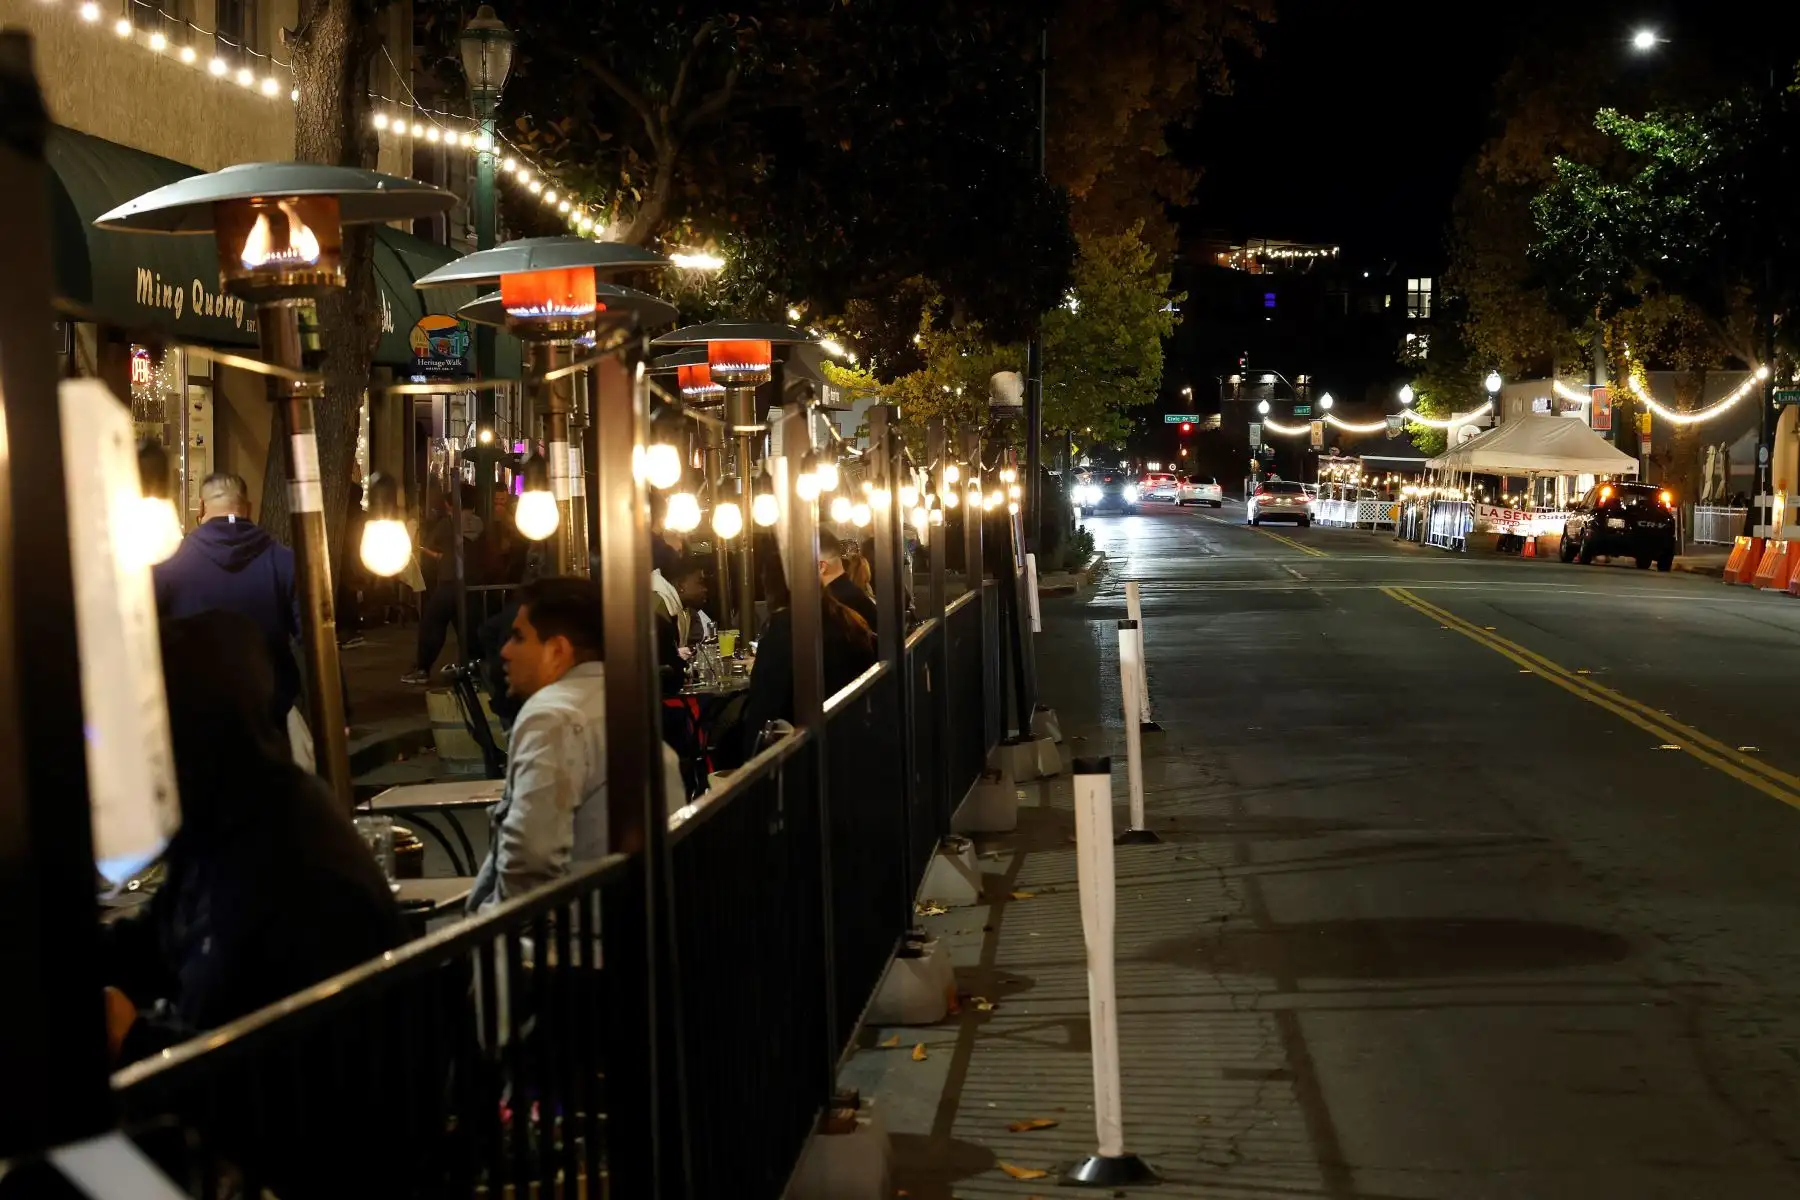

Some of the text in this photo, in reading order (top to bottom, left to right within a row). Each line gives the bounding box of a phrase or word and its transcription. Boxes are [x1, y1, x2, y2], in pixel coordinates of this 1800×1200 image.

[136, 266, 244, 329] Ming Quong
[417, 358, 462, 367] Heritage Walk
[131, 357, 149, 383] OPEN
[1778, 392, 1800, 402] Linc
[1480, 506, 1499, 518] LA
[1503, 510, 1532, 521] SEN
[1637, 520, 1667, 528] CR-V
